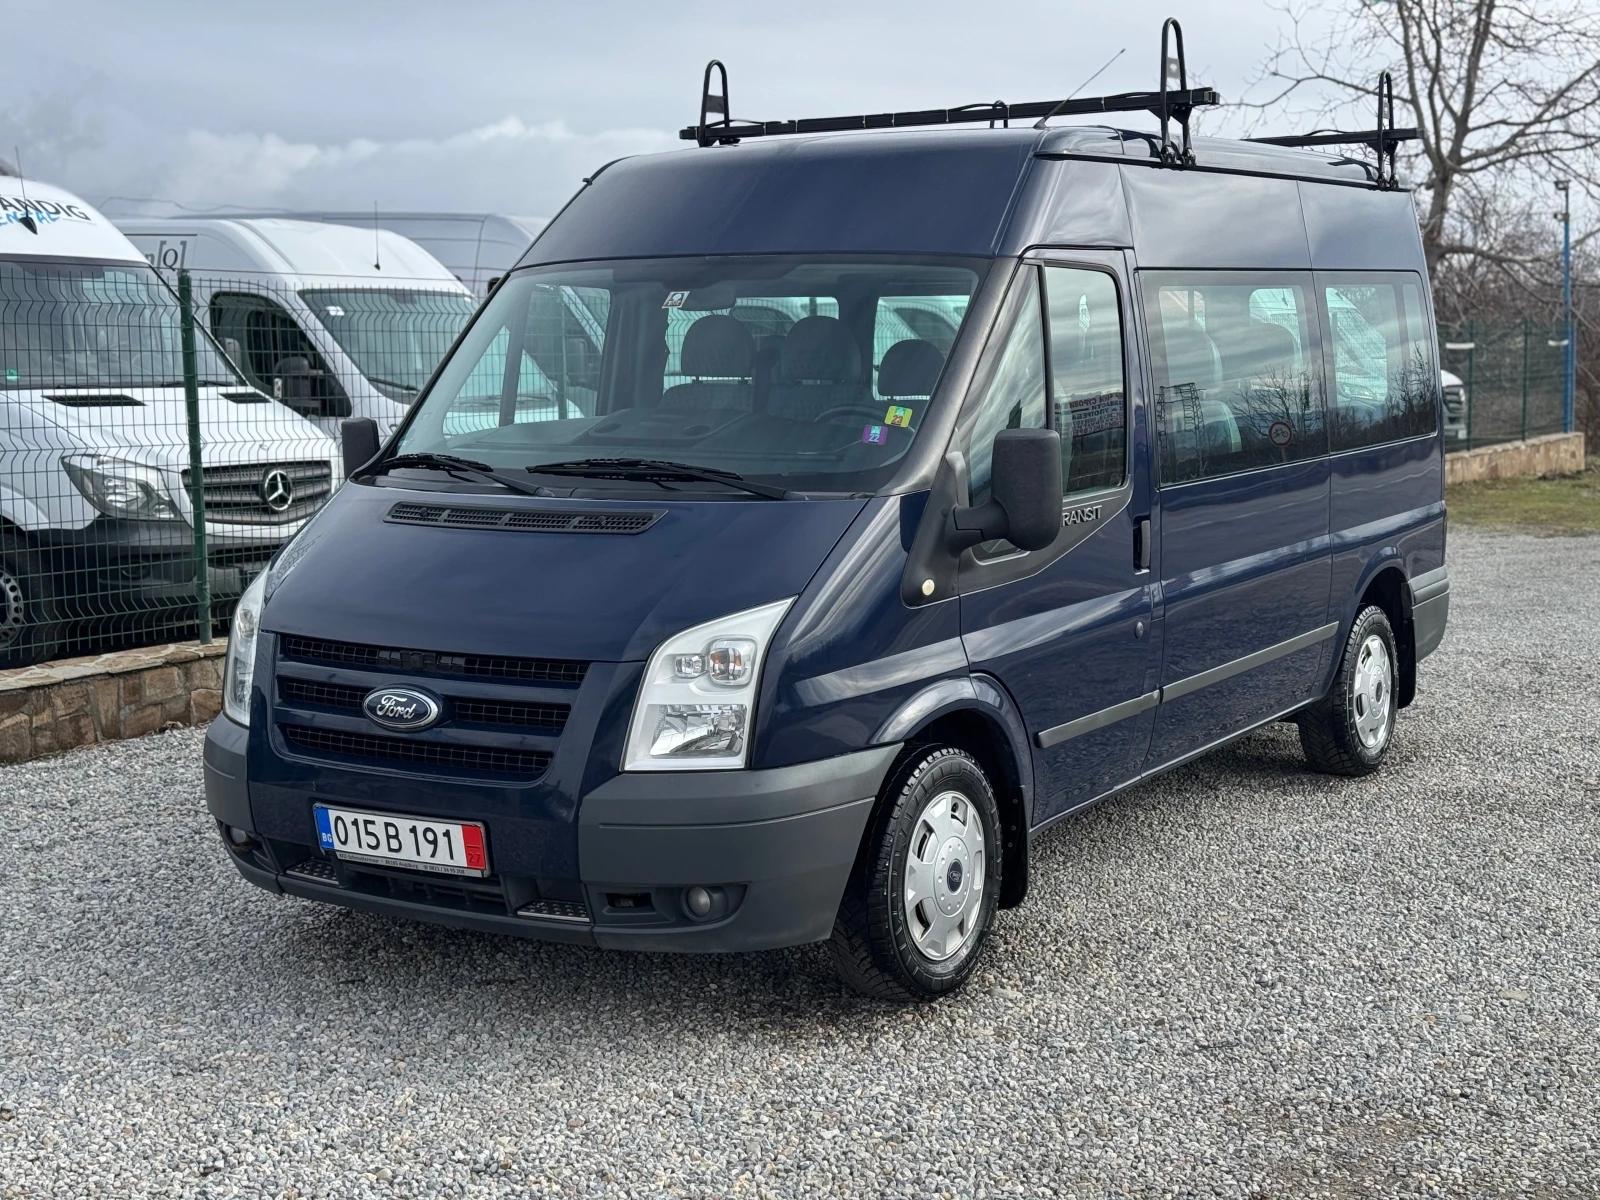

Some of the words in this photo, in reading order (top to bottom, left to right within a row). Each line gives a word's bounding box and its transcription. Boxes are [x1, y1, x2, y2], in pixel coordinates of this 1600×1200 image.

[868, 433, 880, 442] 22
[1062, 505, 1102, 527] RANSIT
[376, 695, 417, 719] Ford
[322, 832, 333, 843] BG
[468, 853, 481, 864] 27
